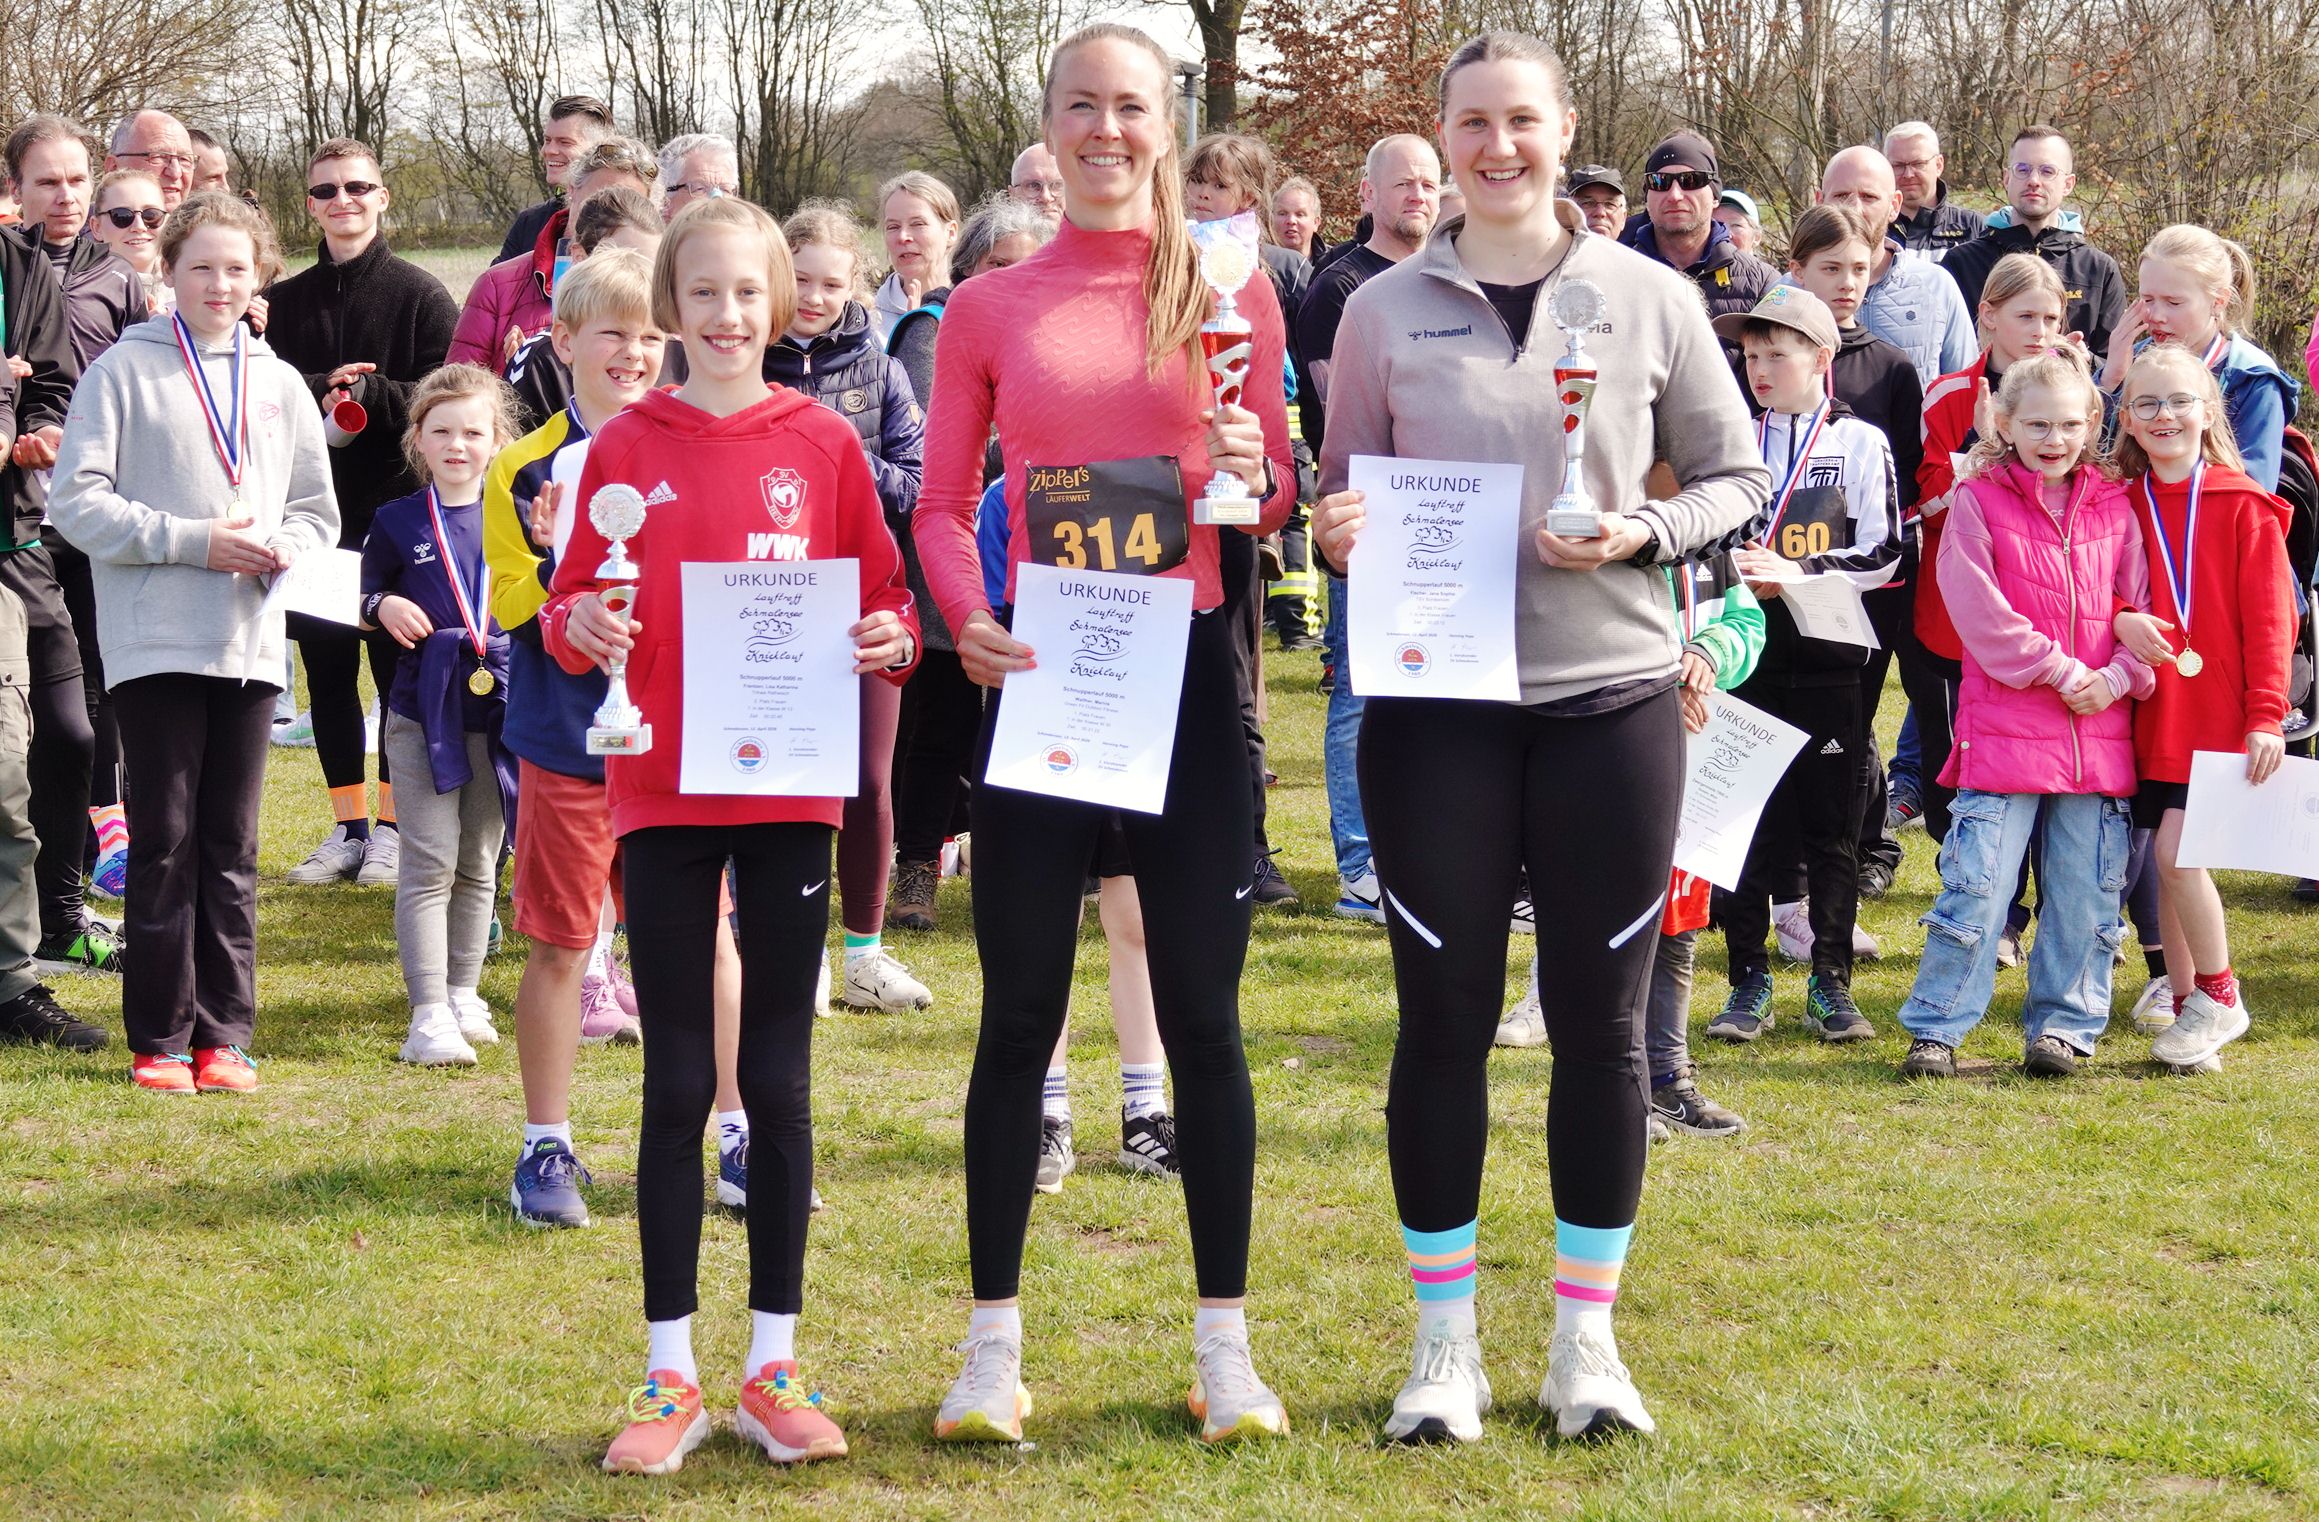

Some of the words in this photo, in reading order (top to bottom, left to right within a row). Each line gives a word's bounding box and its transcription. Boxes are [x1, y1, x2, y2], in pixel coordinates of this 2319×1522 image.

[1423, 324, 1472, 338] hummel
[1390, 474, 1482, 493] URKUNDE
[645, 493, 678, 506] adidas
[747, 532, 810, 562] WWK
[1053, 512, 1163, 571] 314
[1767, 521, 1831, 559] 60
[1407, 556, 1463, 571] Knicklauf
[724, 572, 818, 587] URKUNDE
[1059, 581, 1152, 605] URKUNDE
[745, 650, 804, 663] Knicklauf
[1069, 662, 1129, 681] Knicklauf
[1716, 705, 1777, 745] URKUNDE
